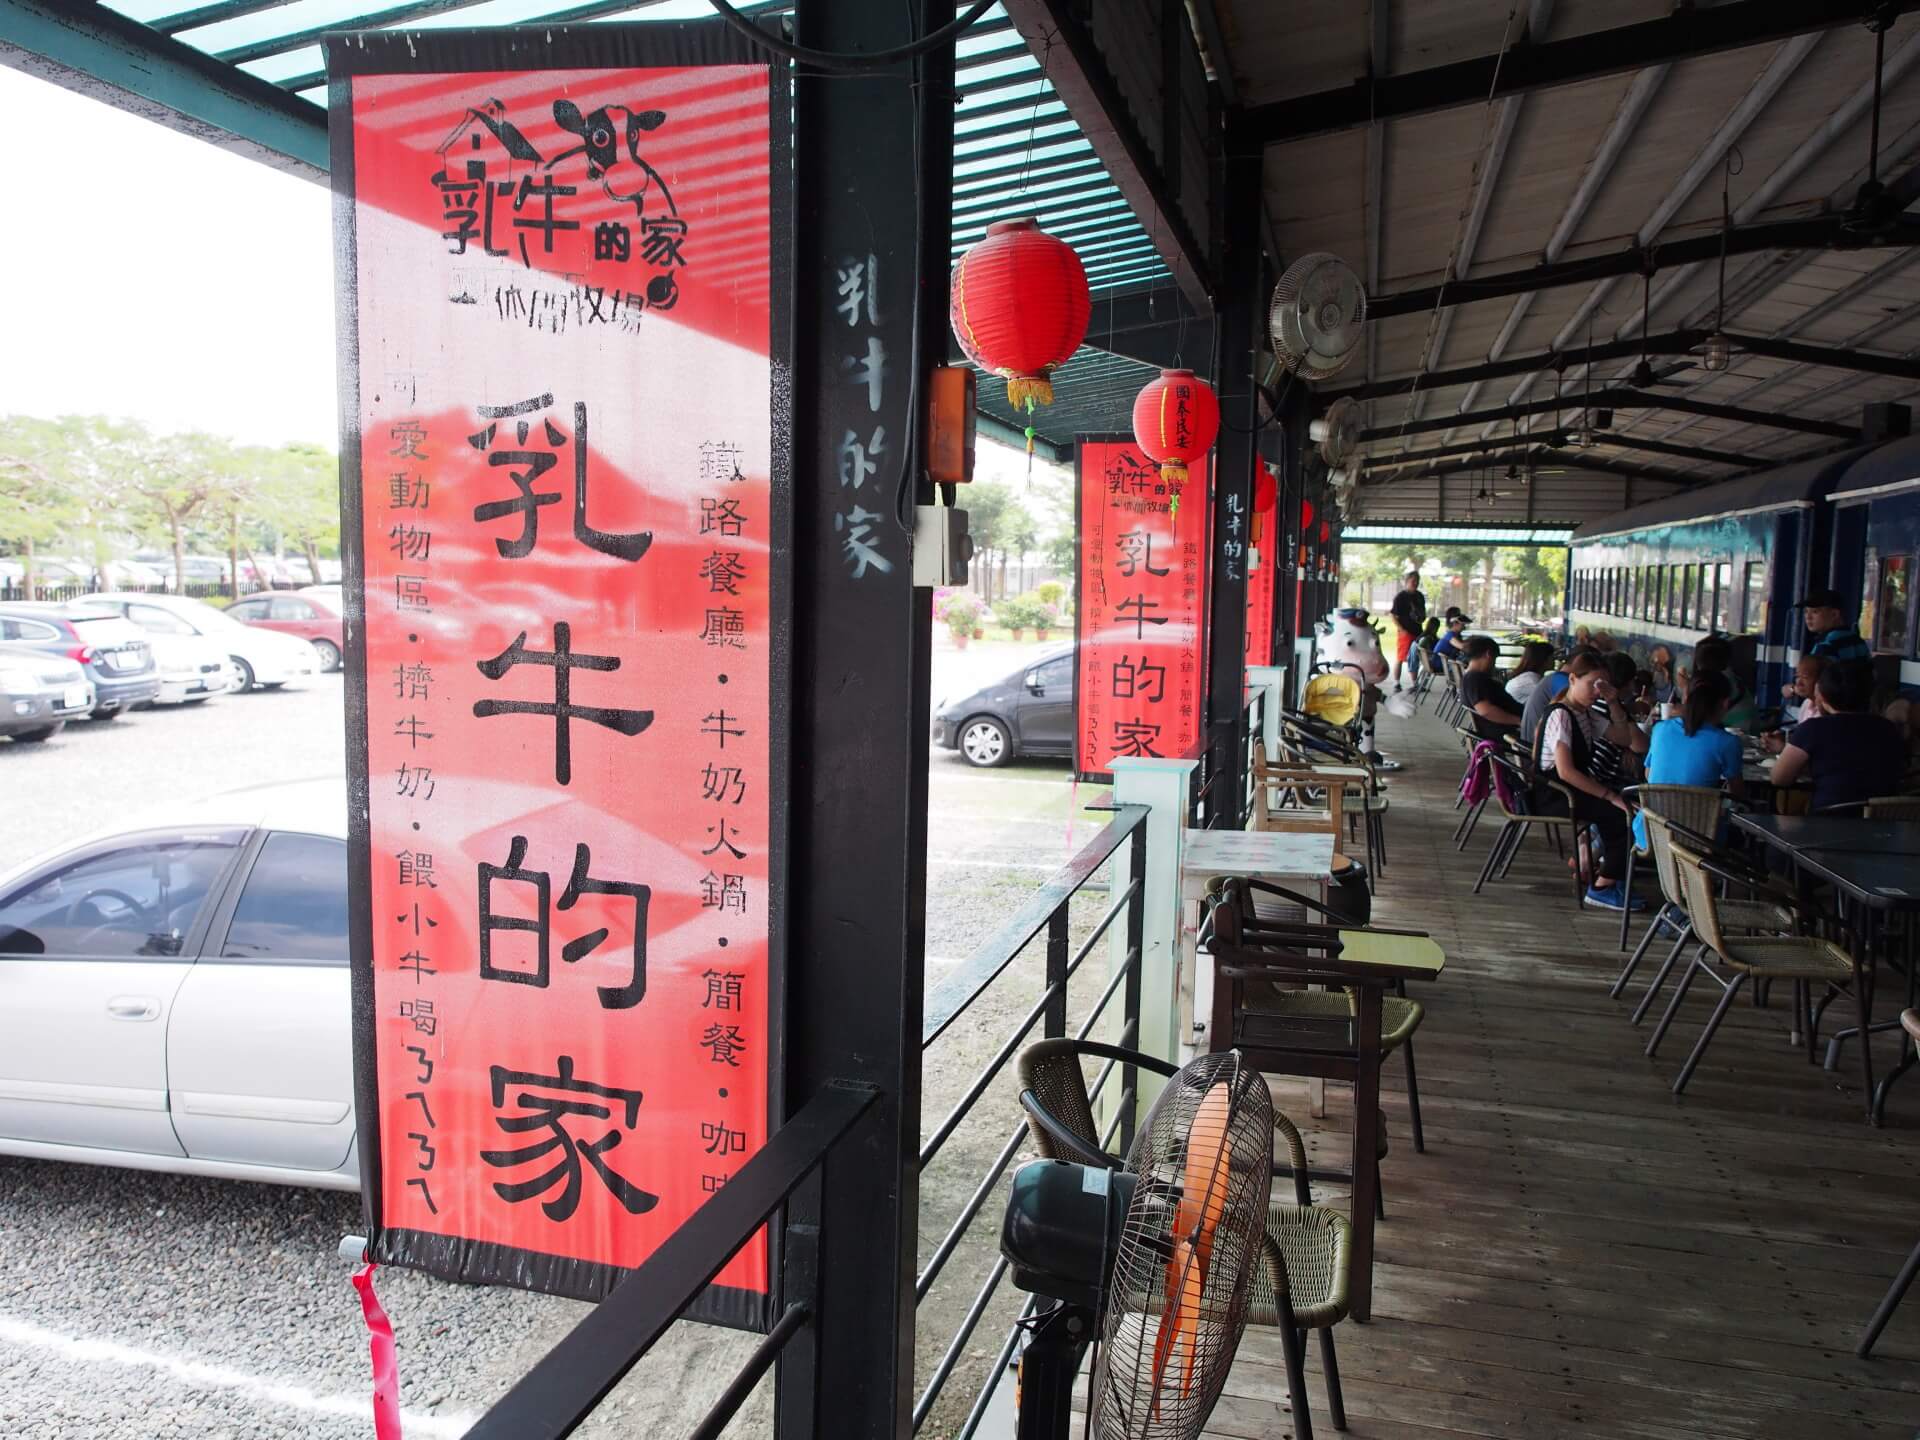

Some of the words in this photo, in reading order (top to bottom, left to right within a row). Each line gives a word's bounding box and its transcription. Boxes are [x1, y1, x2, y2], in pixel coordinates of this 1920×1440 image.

[432, 173, 687, 268] 乳牛的家
[836, 253, 893, 579] 乳牛的家
[1110, 530, 1170, 758] 乳牛的家
[471, 391, 660, 1222] 乳牛的家
